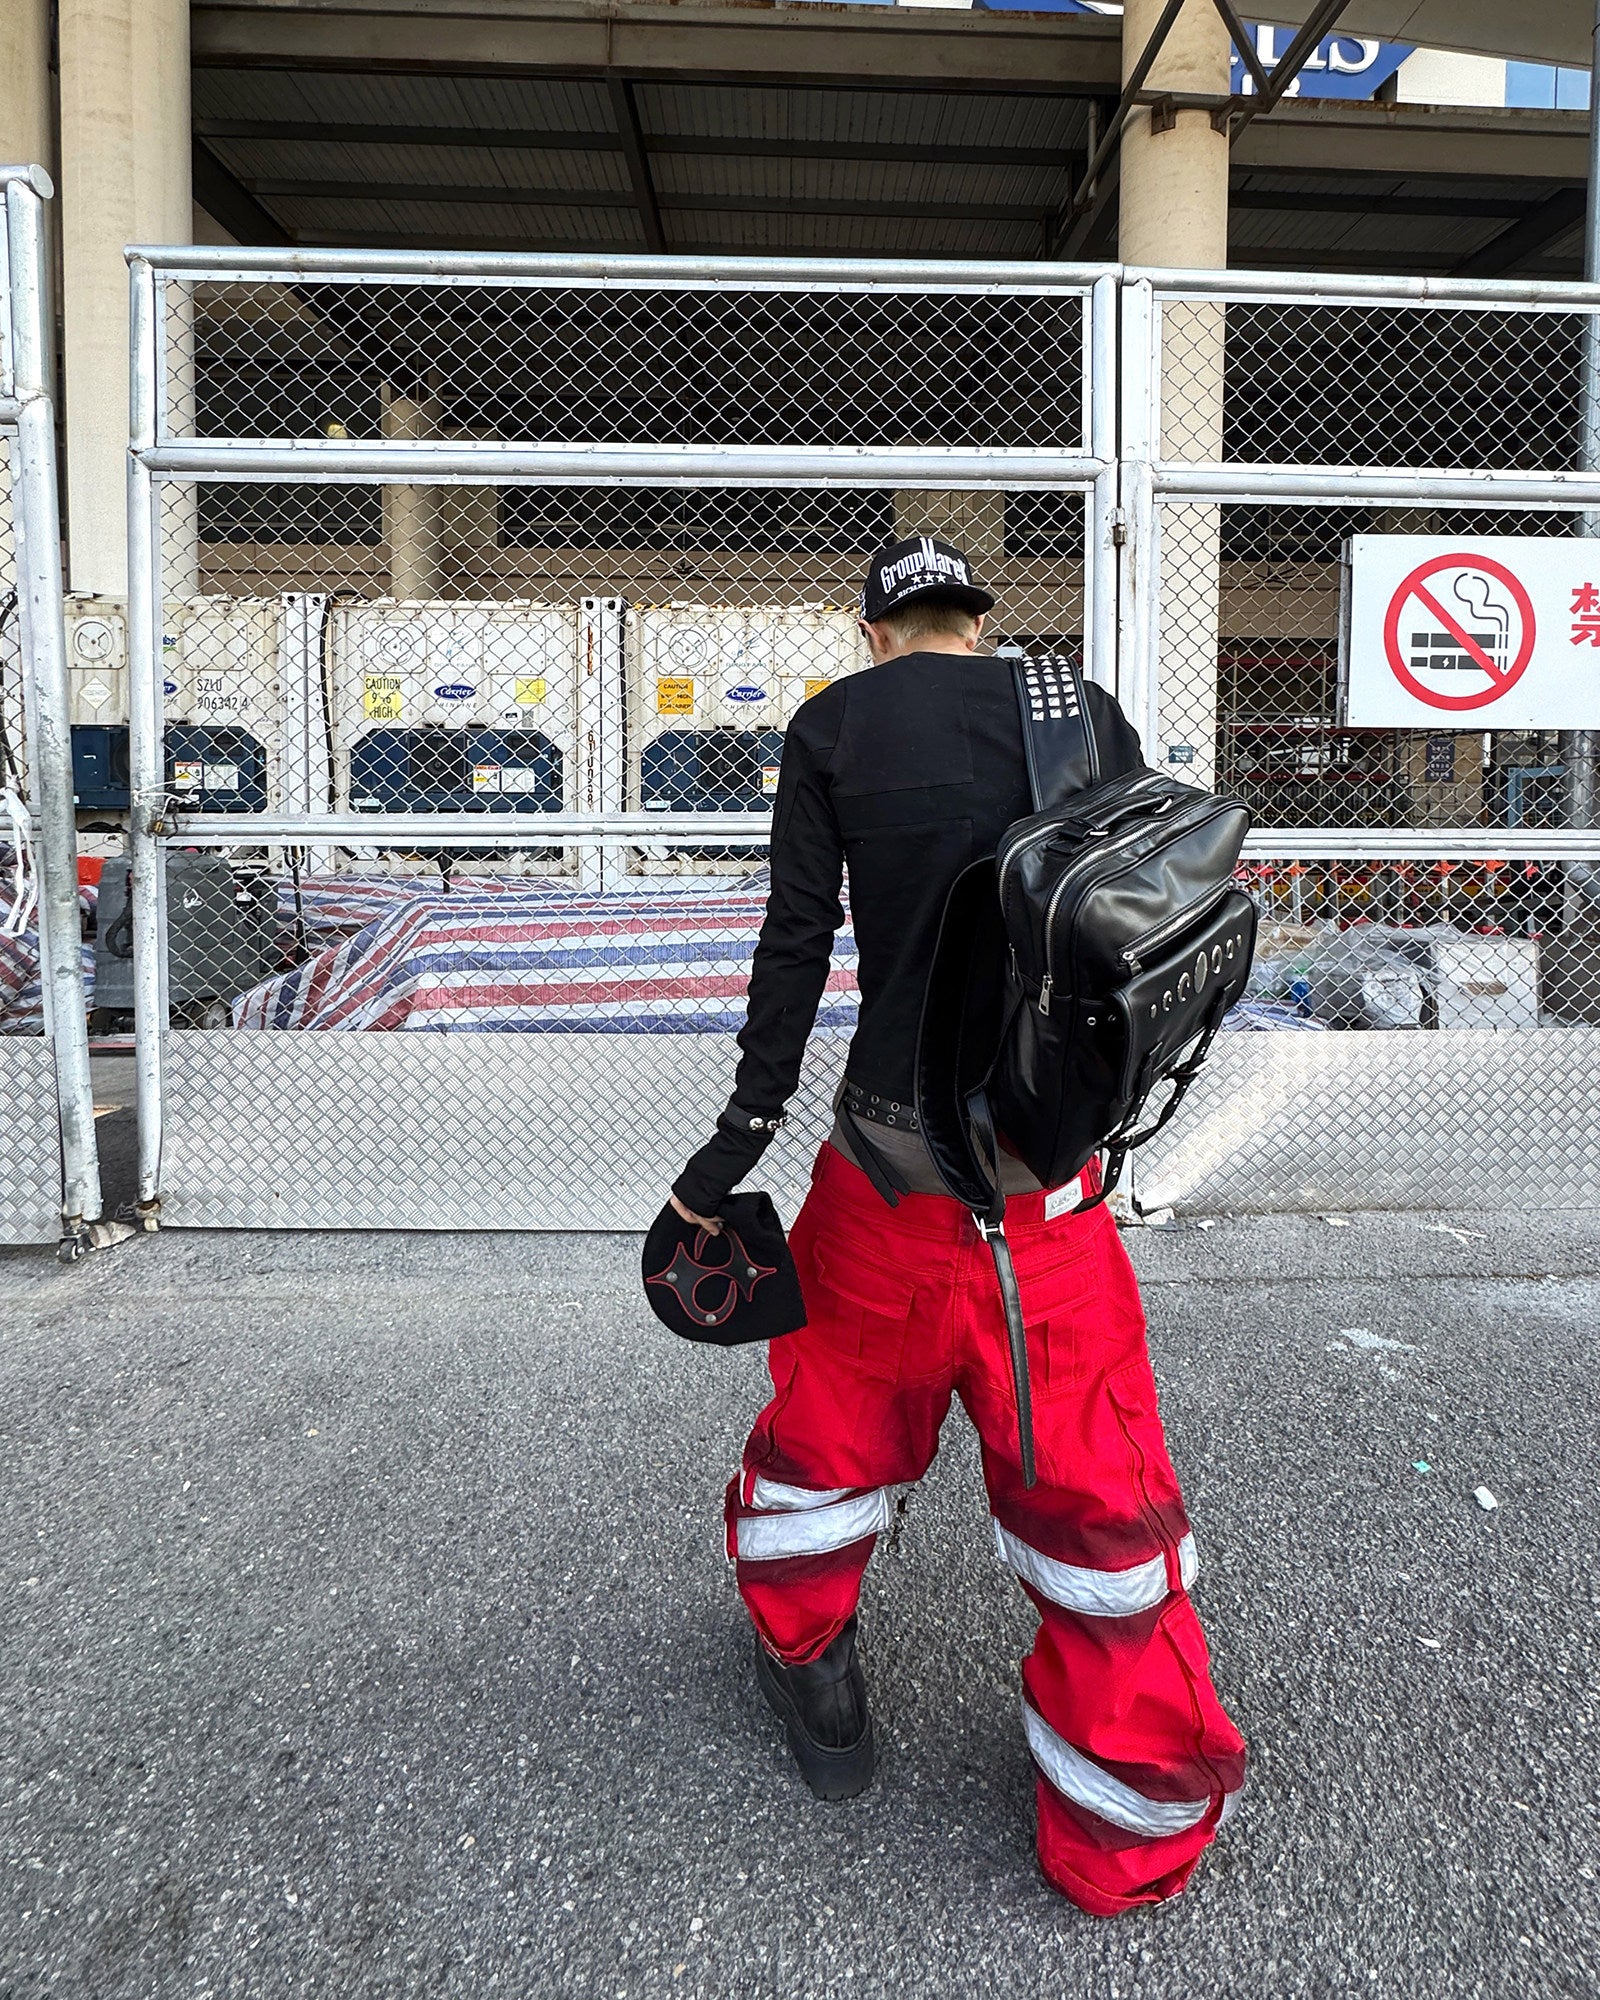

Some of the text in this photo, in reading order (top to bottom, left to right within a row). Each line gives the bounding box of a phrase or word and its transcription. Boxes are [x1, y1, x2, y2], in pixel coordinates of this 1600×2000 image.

[366, 678, 400, 690] CAUTION
[438, 686, 474, 697] Carrier
[730, 688, 763, 699] Carrier
[373, 705, 393, 718] HIGH
